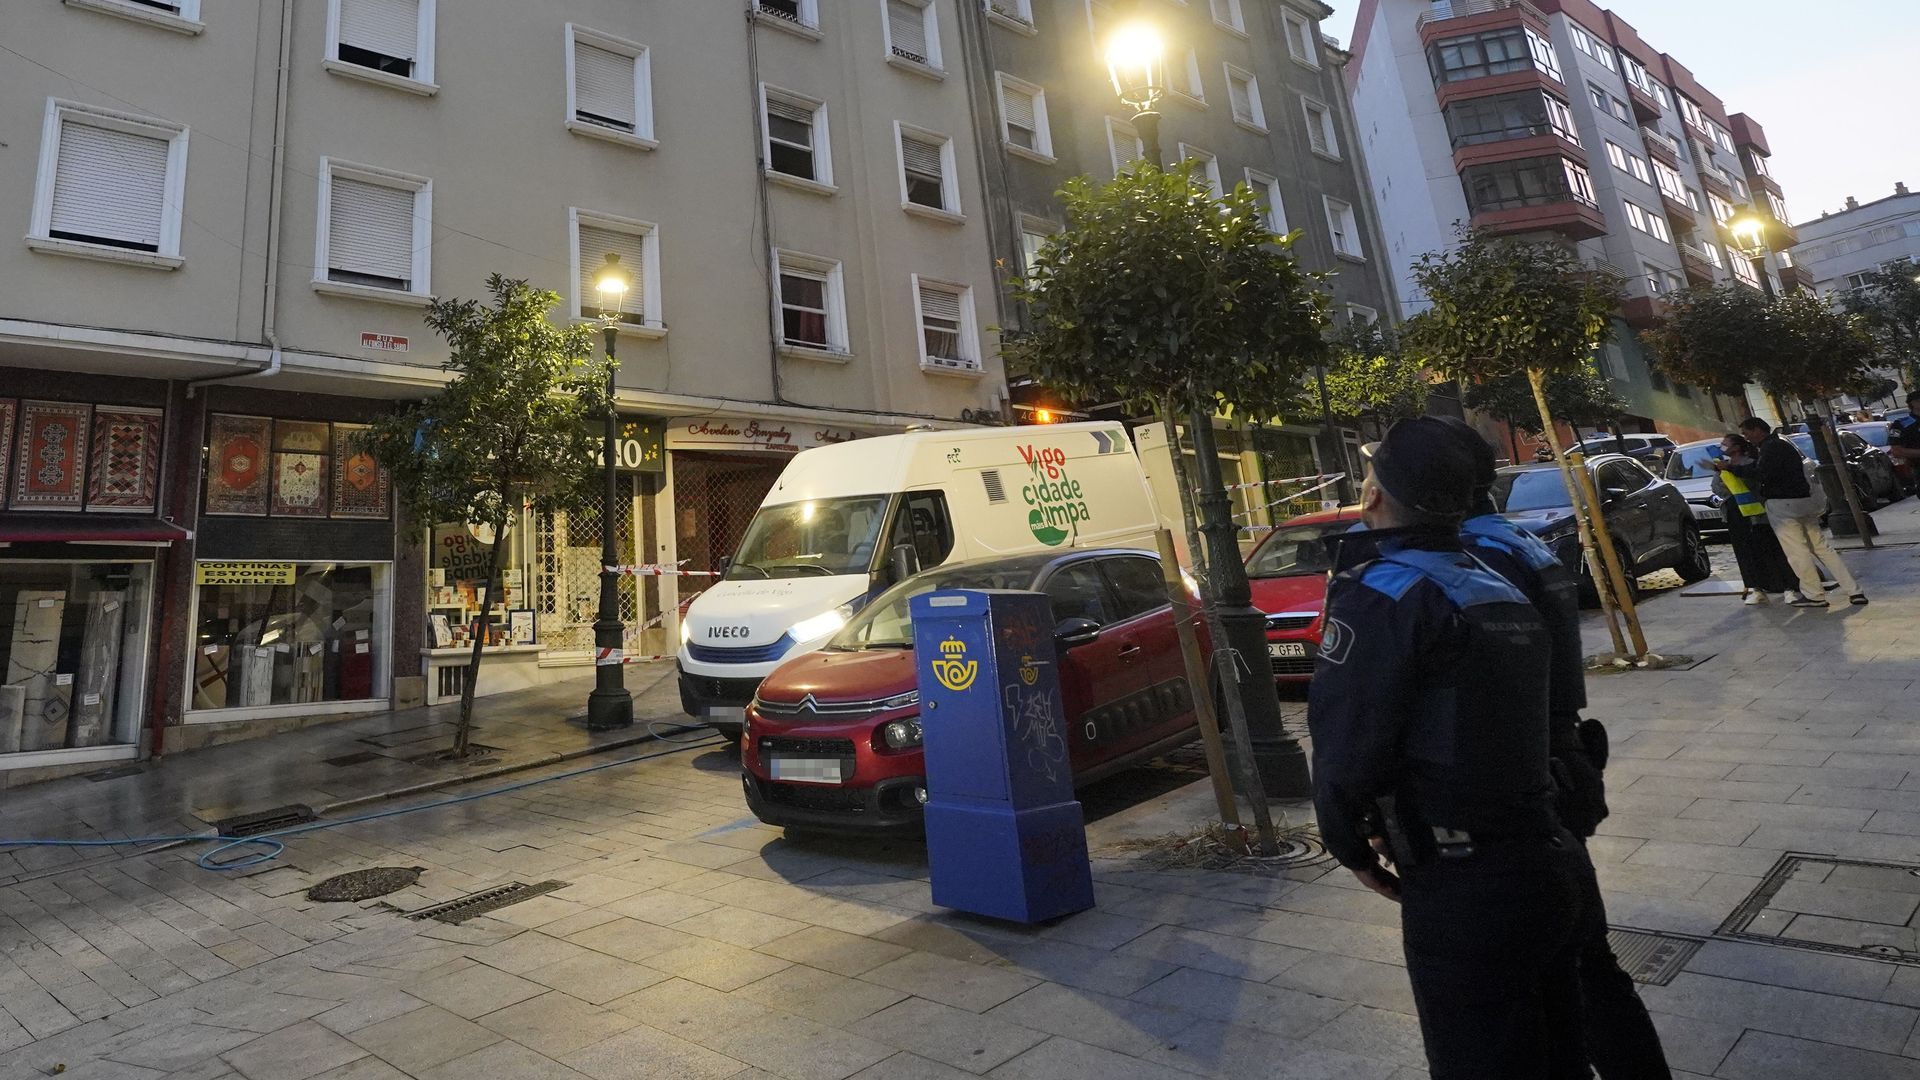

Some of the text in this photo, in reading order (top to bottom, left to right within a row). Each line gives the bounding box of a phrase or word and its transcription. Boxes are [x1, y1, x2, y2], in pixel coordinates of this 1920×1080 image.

[1016, 445, 1066, 479] Vigo
[1022, 468, 1083, 505] cidade
[708, 626, 750, 638] IVECO
[1279, 644, 1301, 656] GFR
